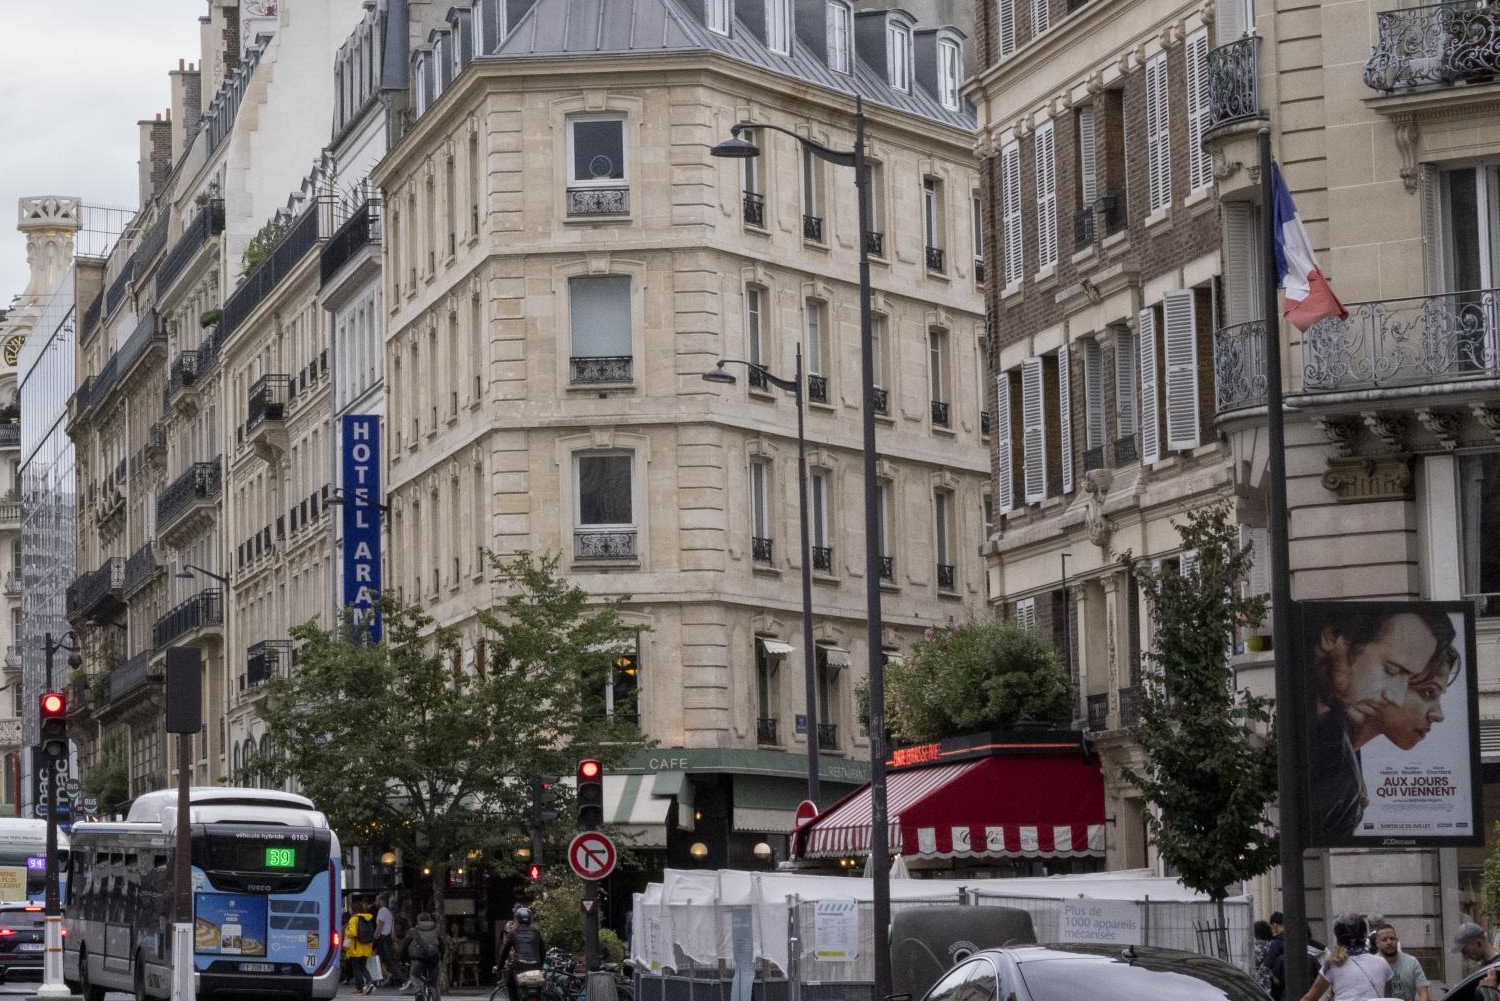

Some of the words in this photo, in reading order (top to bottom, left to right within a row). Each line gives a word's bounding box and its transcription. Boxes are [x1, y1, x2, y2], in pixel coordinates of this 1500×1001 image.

[352, 421, 371, 529] HOTEL
[649, 758, 688, 770] CAFE
[828, 766, 867, 781] RESTAURANT
[55, 759, 68, 806] nac
[1384, 776, 1408, 787] AUX
[1410, 776, 1449, 787] JOURS
[1376, 786, 1398, 798] QUI
[1400, 786, 1457, 797] VIENNENT
[29, 860, 42, 868] 94
[270, 849, 291, 866] 39
[1065, 905, 1086, 916] Plus
[1089, 906, 1102, 917] de
[1065, 916, 1092, 928] 1000
[1093, 919, 1137, 930] appareils
[306, 954, 316, 967] 70
